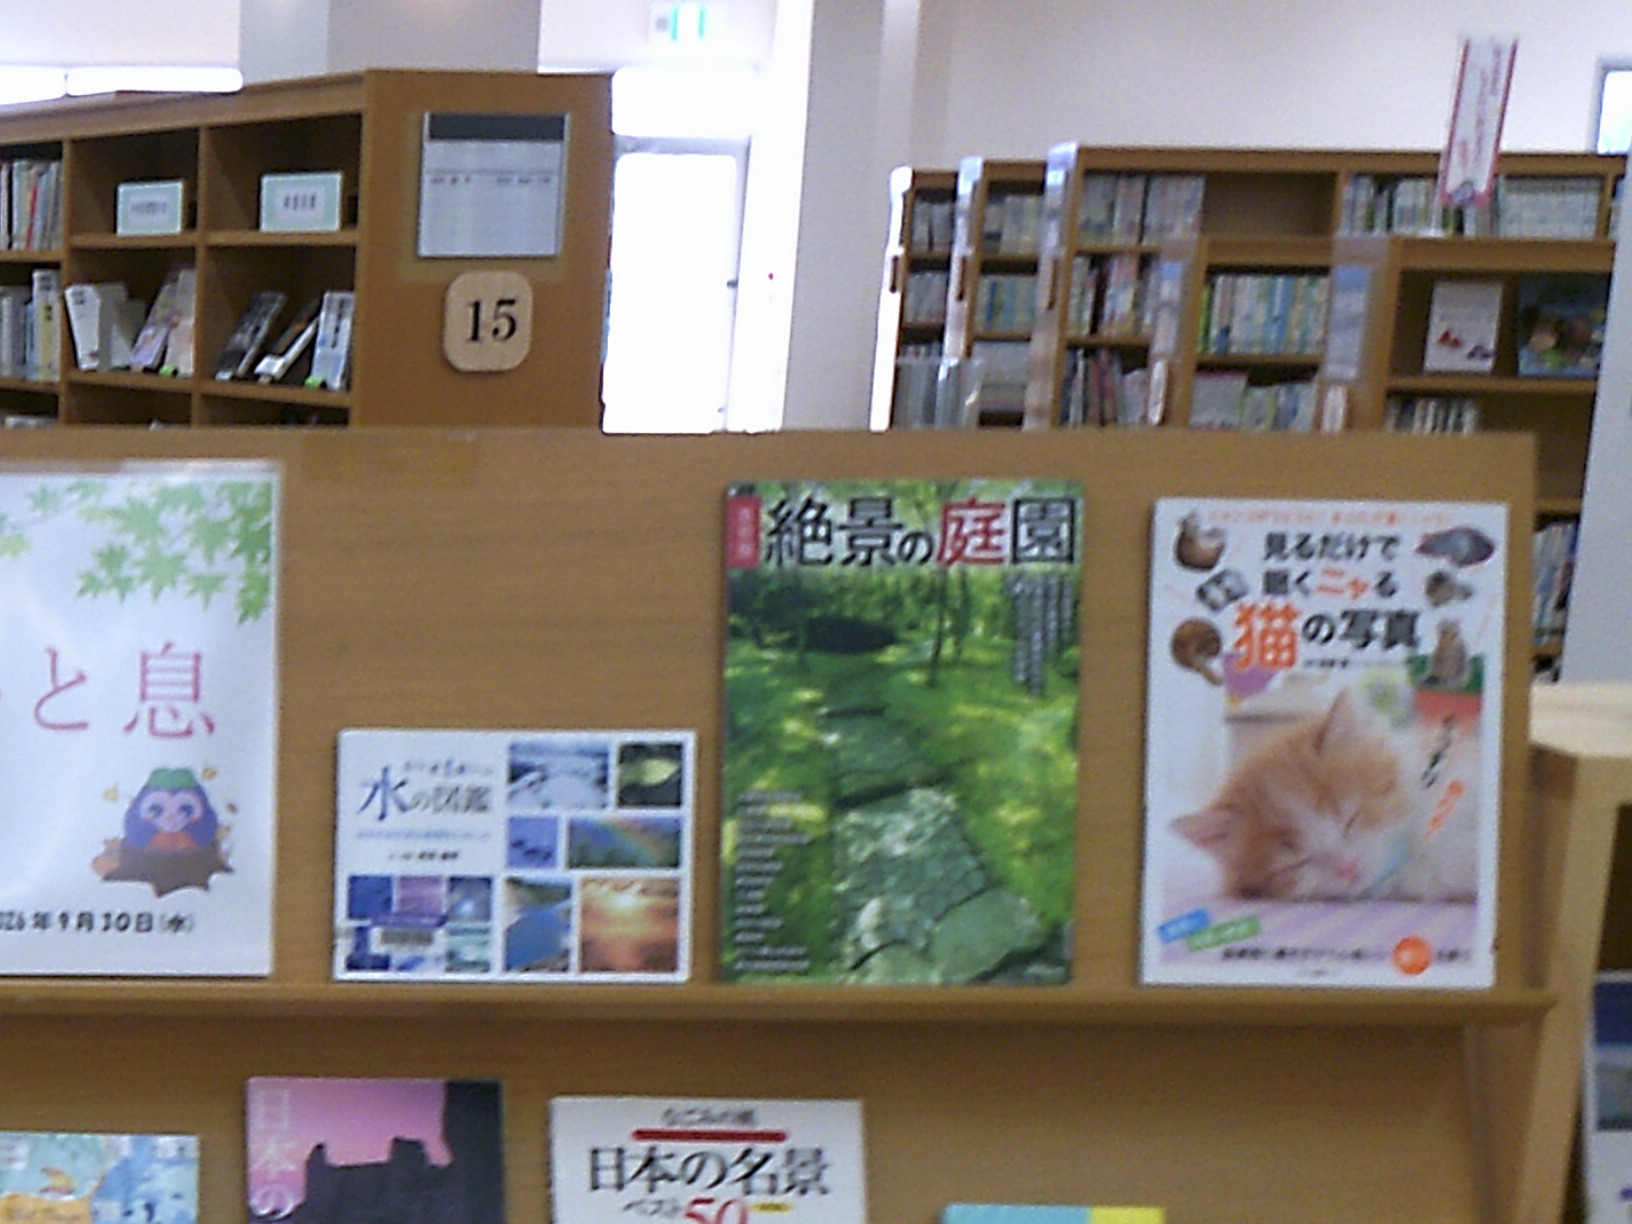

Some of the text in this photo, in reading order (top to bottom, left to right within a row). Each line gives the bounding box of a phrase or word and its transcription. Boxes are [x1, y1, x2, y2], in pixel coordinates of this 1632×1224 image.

[466, 298, 517, 343] 15
[767, 497, 1076, 566] 絶景の庭園
[589, 1146, 833, 1197] 日本の名景
